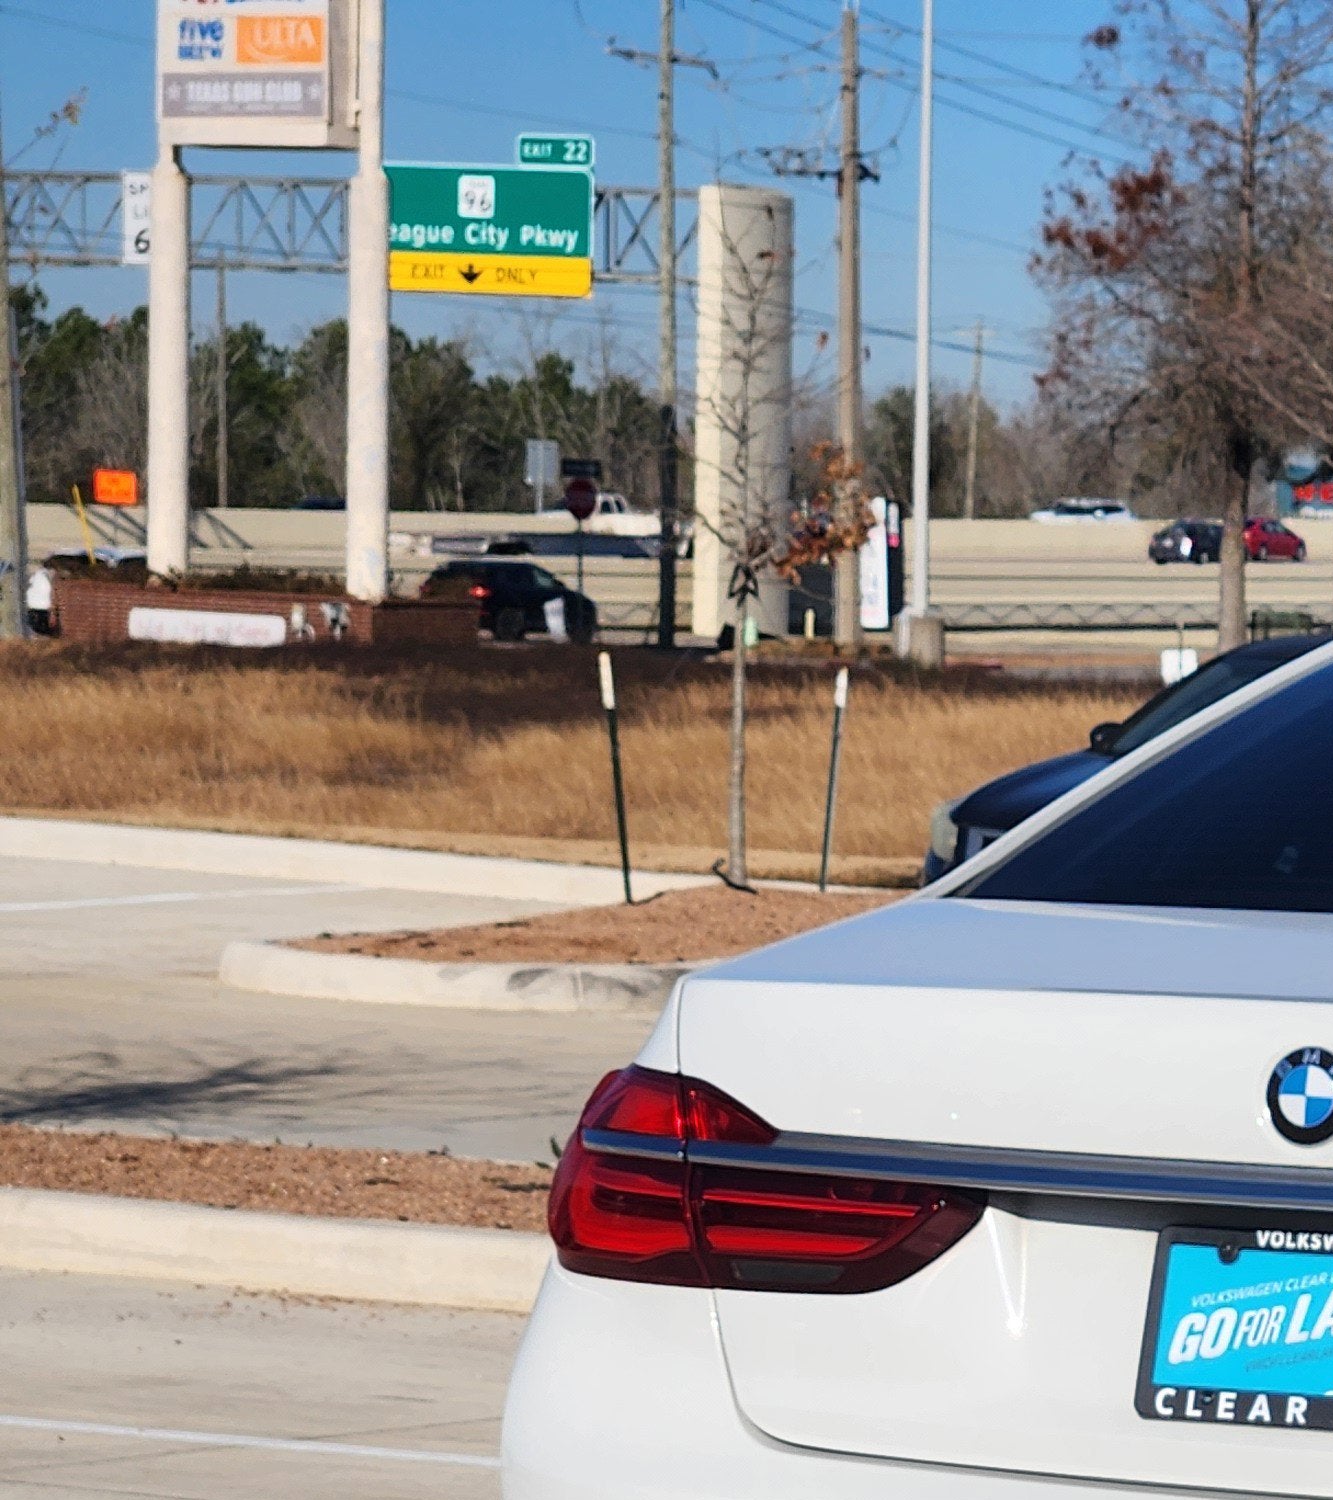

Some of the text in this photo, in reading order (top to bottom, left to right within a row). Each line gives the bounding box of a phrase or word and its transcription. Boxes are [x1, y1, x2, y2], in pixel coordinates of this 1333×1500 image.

[179, 17, 224, 42] five
[252, 20, 318, 48] ULTA
[522, 141, 588, 162] EXIT 22
[464, 190, 492, 212] 96
[390, 221, 579, 253] eague City Pkwy
[411, 262, 538, 284] EXIT ONLY
[1191, 1280, 1284, 1308] VOLKSWAGEN
[1284, 1272, 1328, 1293] CLEAR
[1167, 1306, 1238, 1365] GO
[1232, 1304, 1287, 1350] FOR
[1154, 1386, 1308, 1426] CLEAR
